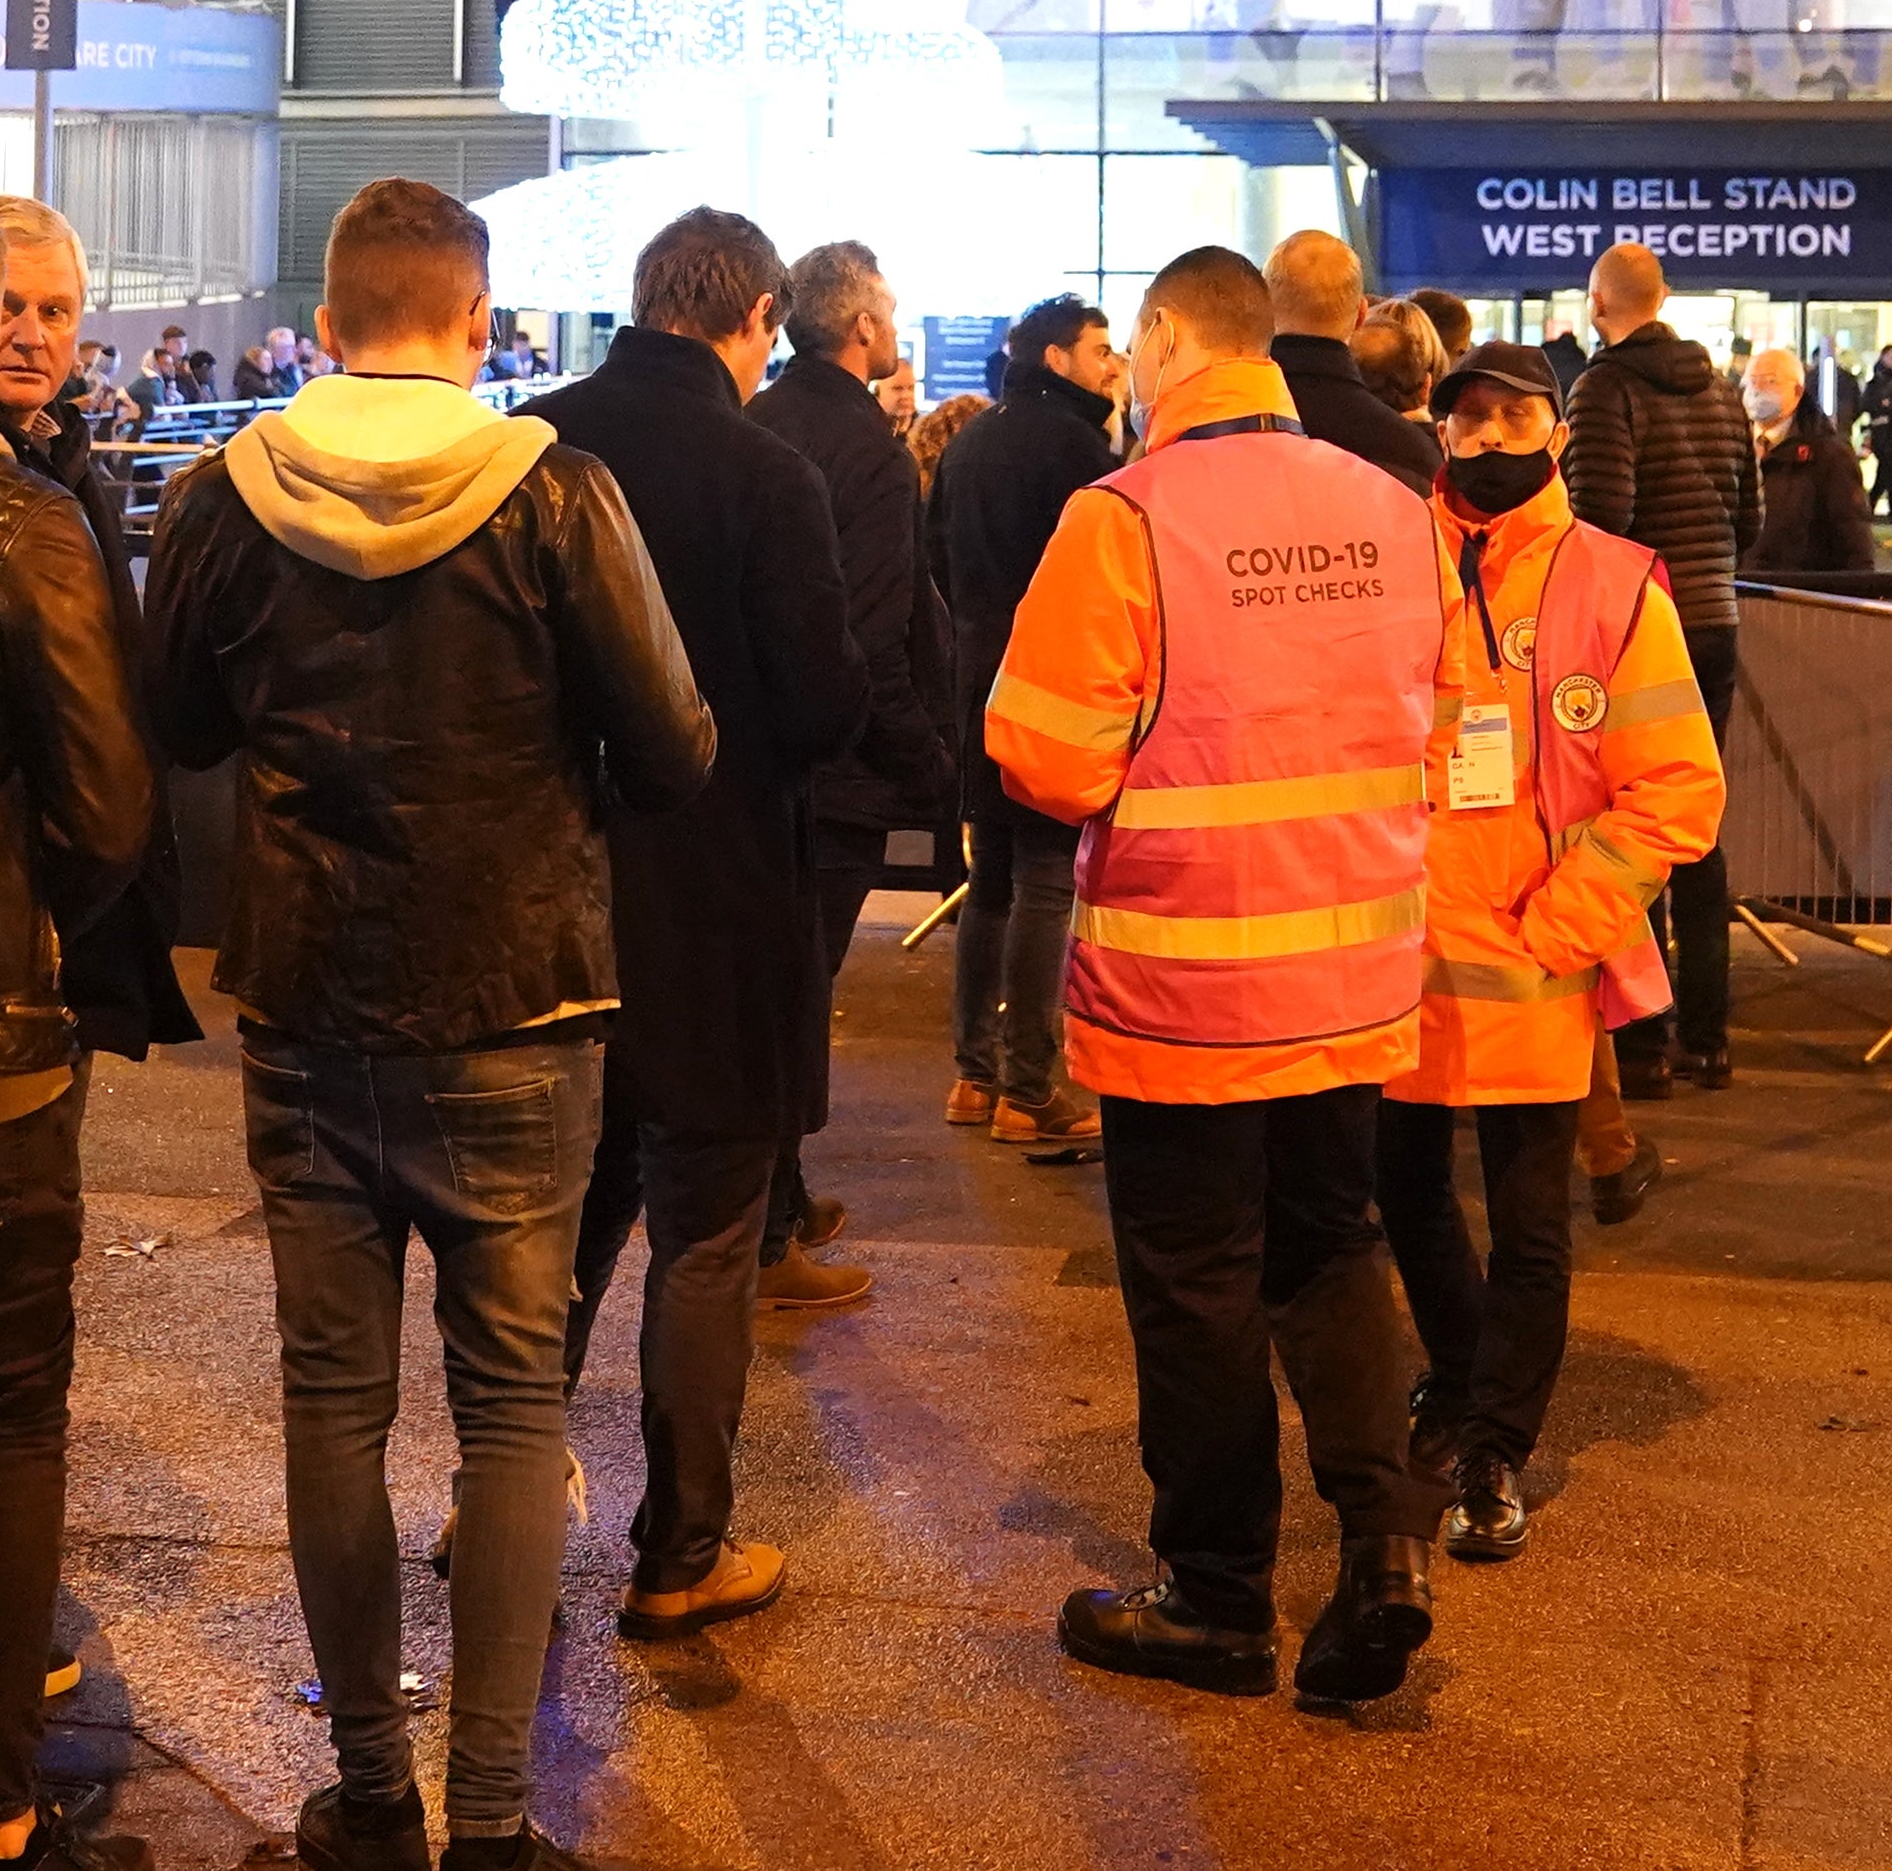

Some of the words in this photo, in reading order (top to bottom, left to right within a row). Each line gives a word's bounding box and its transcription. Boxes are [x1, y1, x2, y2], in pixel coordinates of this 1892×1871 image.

[115, 42, 157, 69] CITY
[1476, 177, 1599, 211] COLIN
[1612, 177, 1712, 211] BELL
[1723, 177, 1857, 211] STAND
[1481, 224, 1602, 257] WEST
[1612, 224, 1852, 258] RECEPTION
[1226, 540, 1379, 578] COVID-19
[1231, 586, 1287, 608] SPOT
[1295, 579, 1385, 603] CHECKS
